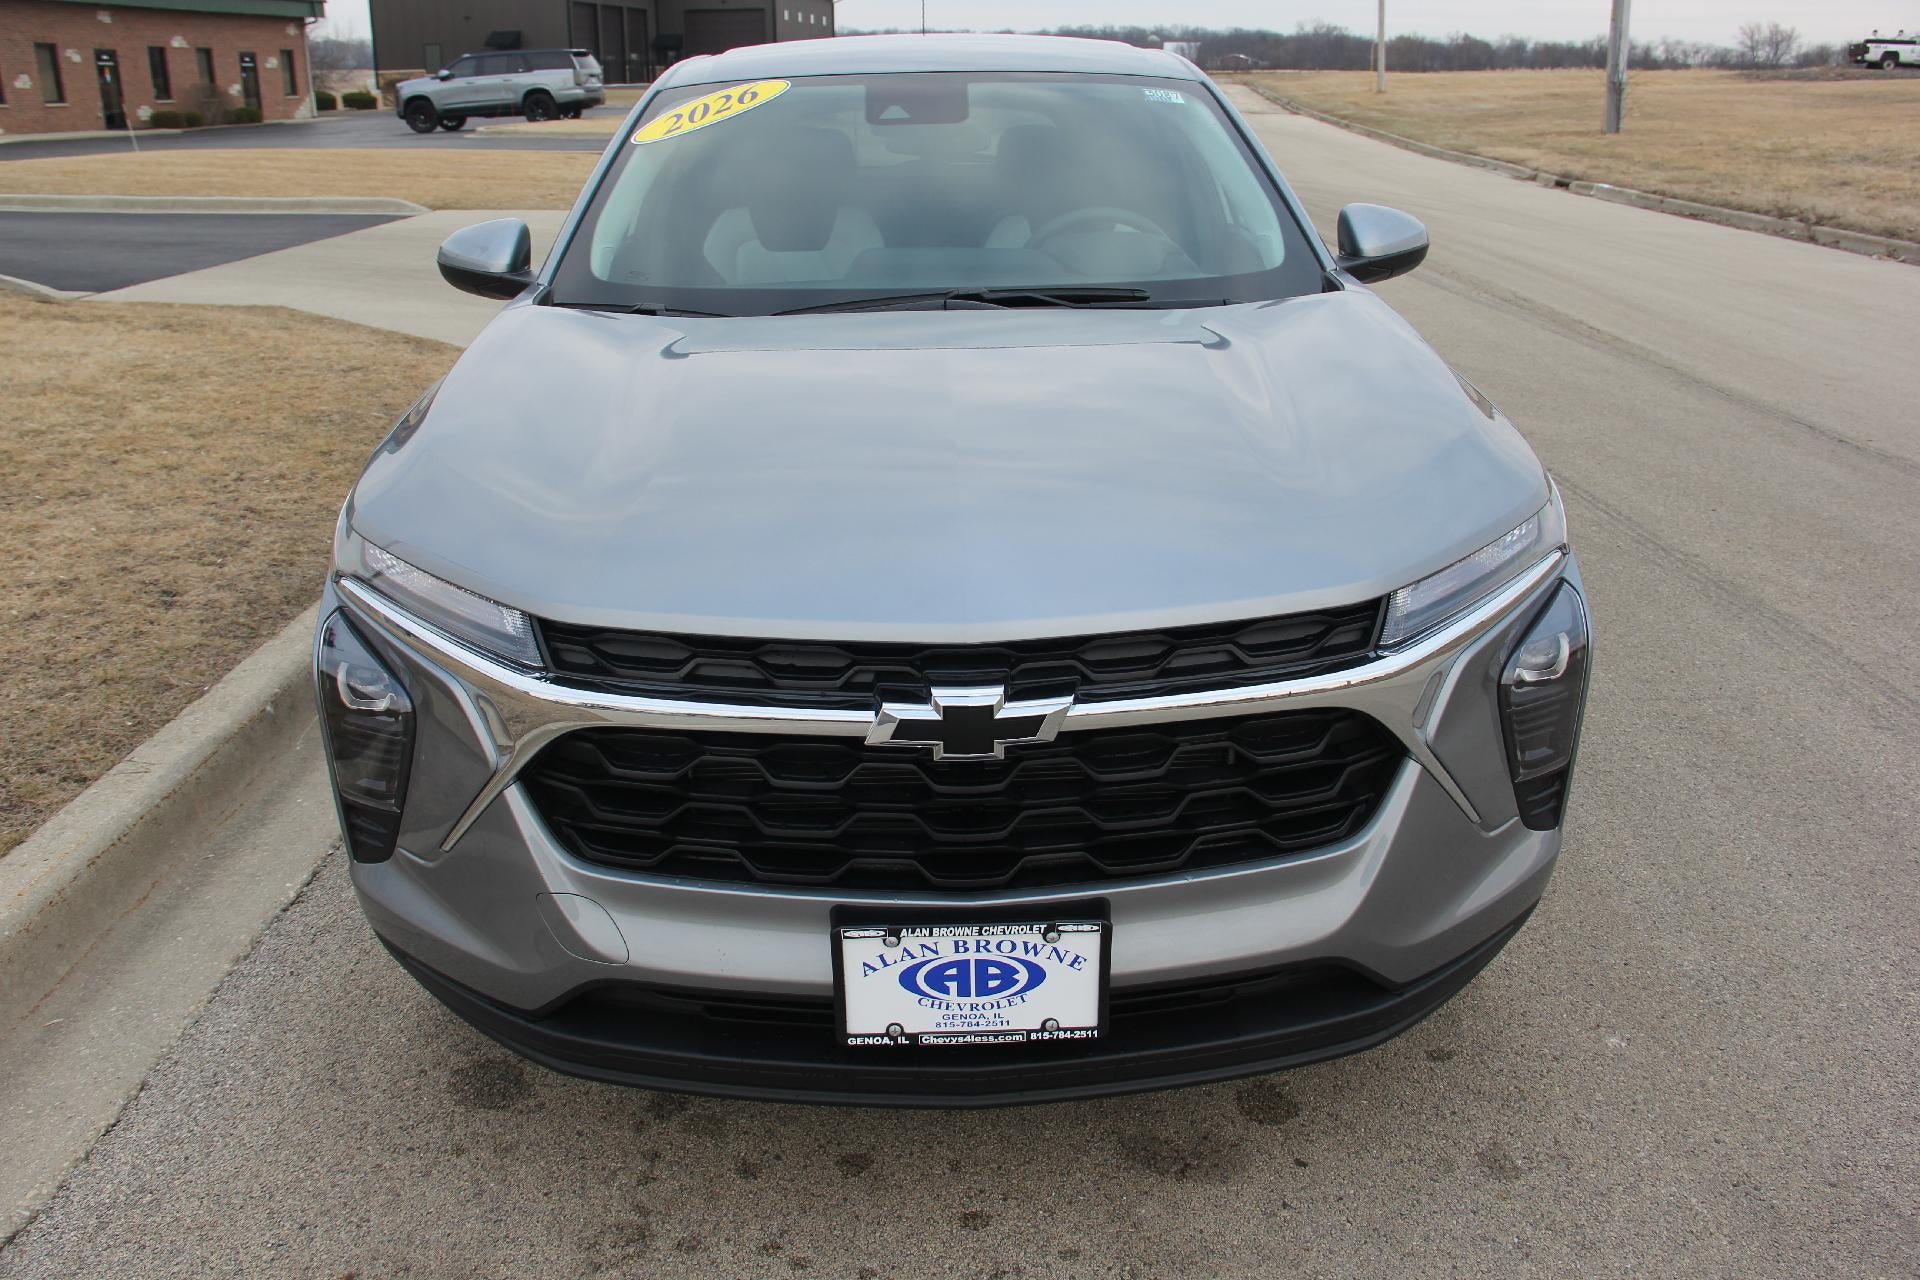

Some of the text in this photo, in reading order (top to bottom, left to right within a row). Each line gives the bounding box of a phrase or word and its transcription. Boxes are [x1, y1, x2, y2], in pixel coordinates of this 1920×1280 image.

[663, 85, 759, 136] 2026
[900, 928, 930, 937] ALAN
[932, 927, 980, 936] BROWNE
[981, 925, 1047, 935] CHEVROLET
[862, 939, 1087, 978] ALAN BROWNE
[923, 958, 1021, 998] AB
[917, 994, 1028, 1011] CHEVROLET
[935, 1020, 1010, 1028] 815-784-2511
[847, 1036, 910, 1046] GENOA, IL
[921, 1034, 1023, 1044] Chevys4less.com
[1030, 1030, 1098, 1040] 815-784-2511
